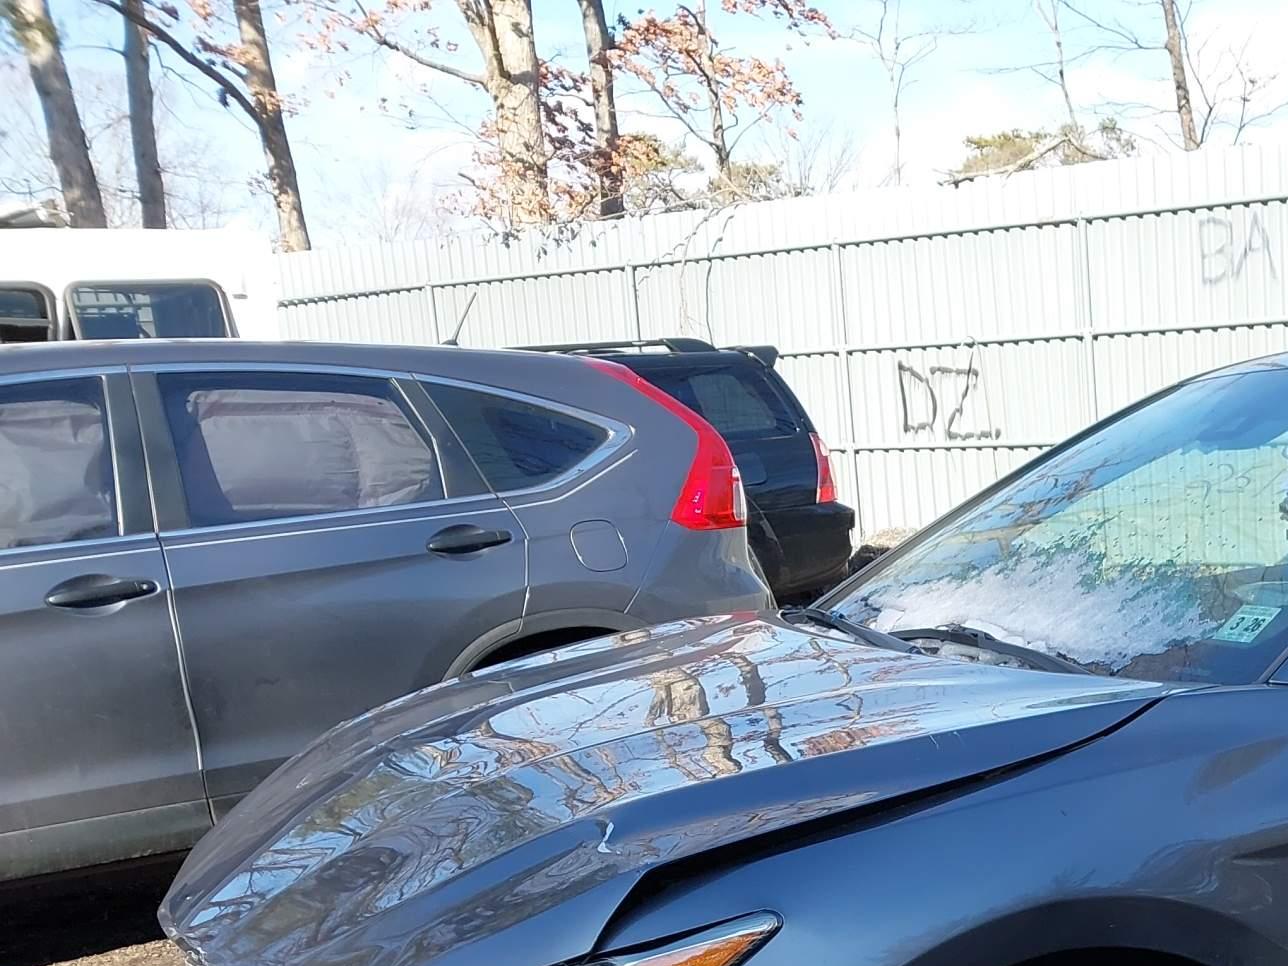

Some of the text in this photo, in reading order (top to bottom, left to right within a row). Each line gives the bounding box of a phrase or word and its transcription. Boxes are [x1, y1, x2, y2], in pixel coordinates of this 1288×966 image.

[1198, 210, 1277, 285] BA
[1230, 616, 1266, 633] 3 26
